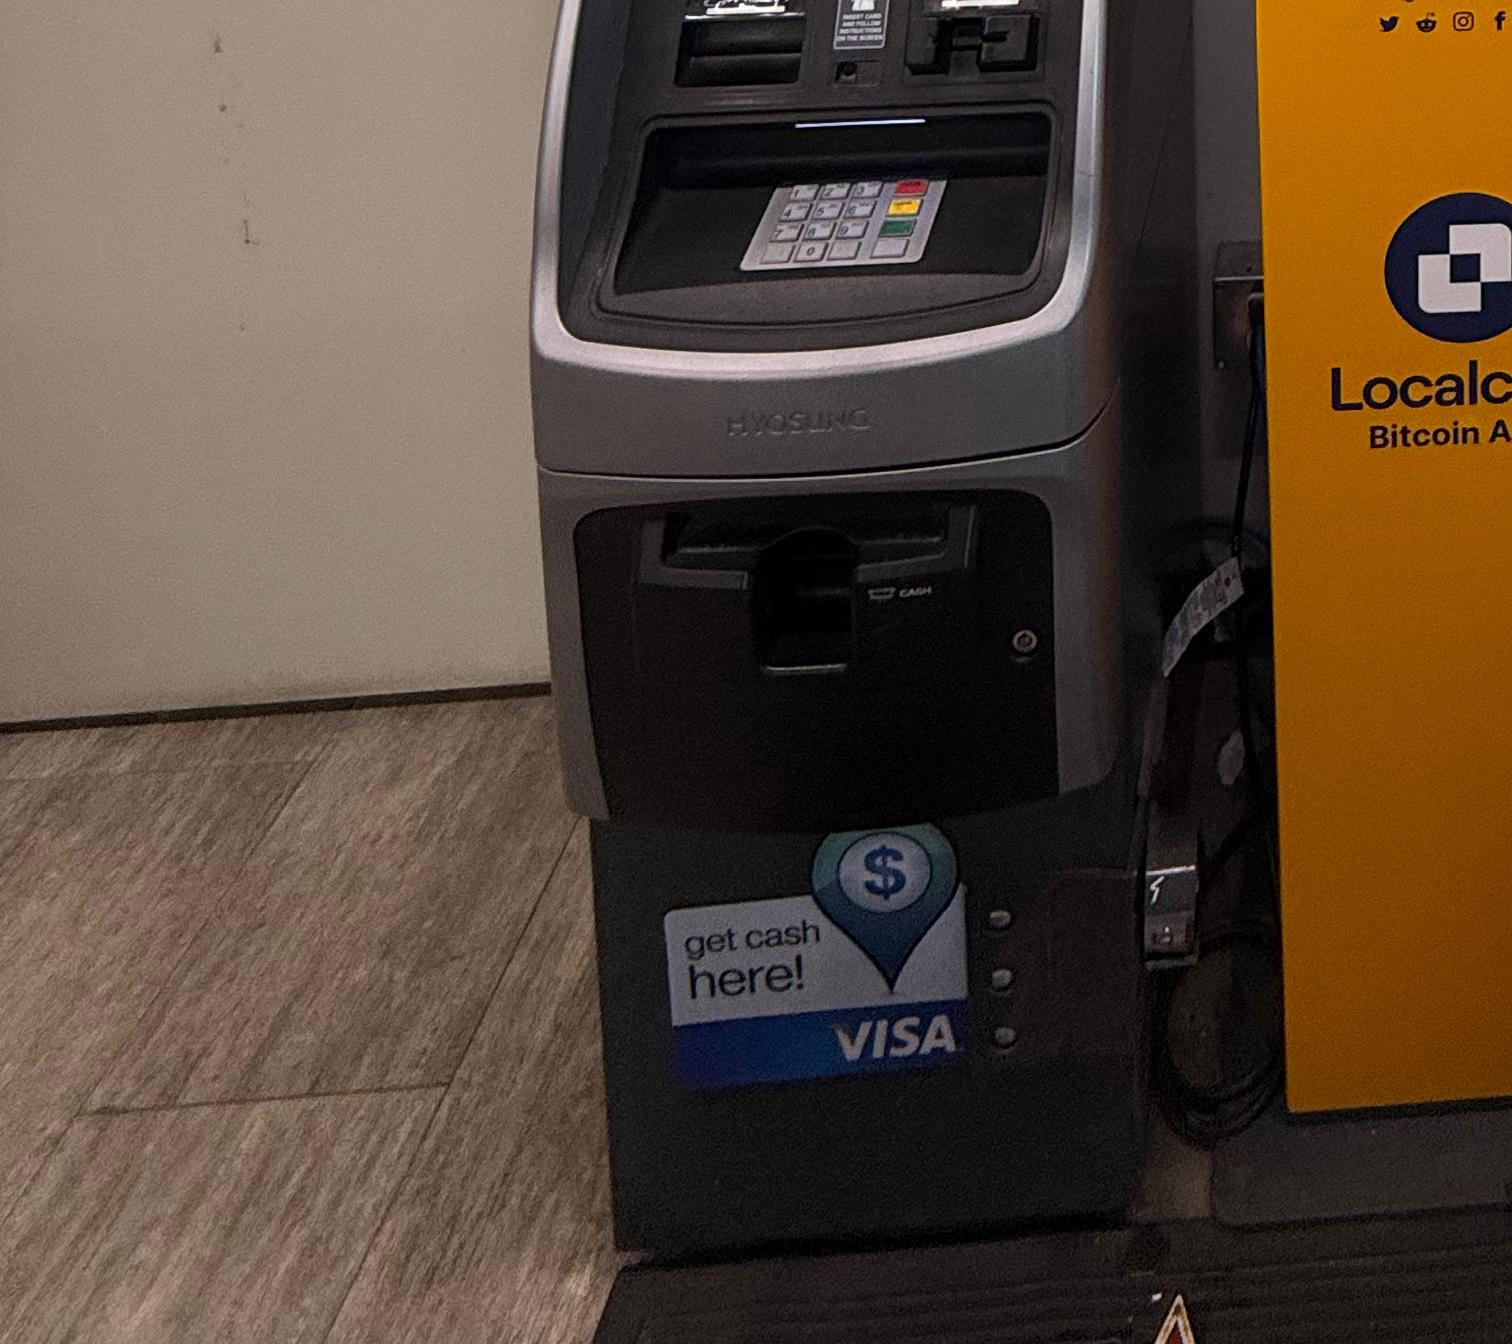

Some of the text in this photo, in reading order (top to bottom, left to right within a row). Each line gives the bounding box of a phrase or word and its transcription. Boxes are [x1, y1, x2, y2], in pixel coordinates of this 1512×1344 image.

[1370, 420, 1479, 449] Bitcoin
[899, 587, 932, 598] CASH
[684, 920, 820, 959] get cash
[688, 955, 804, 1000] here!
[831, 1014, 956, 1062] VISA
